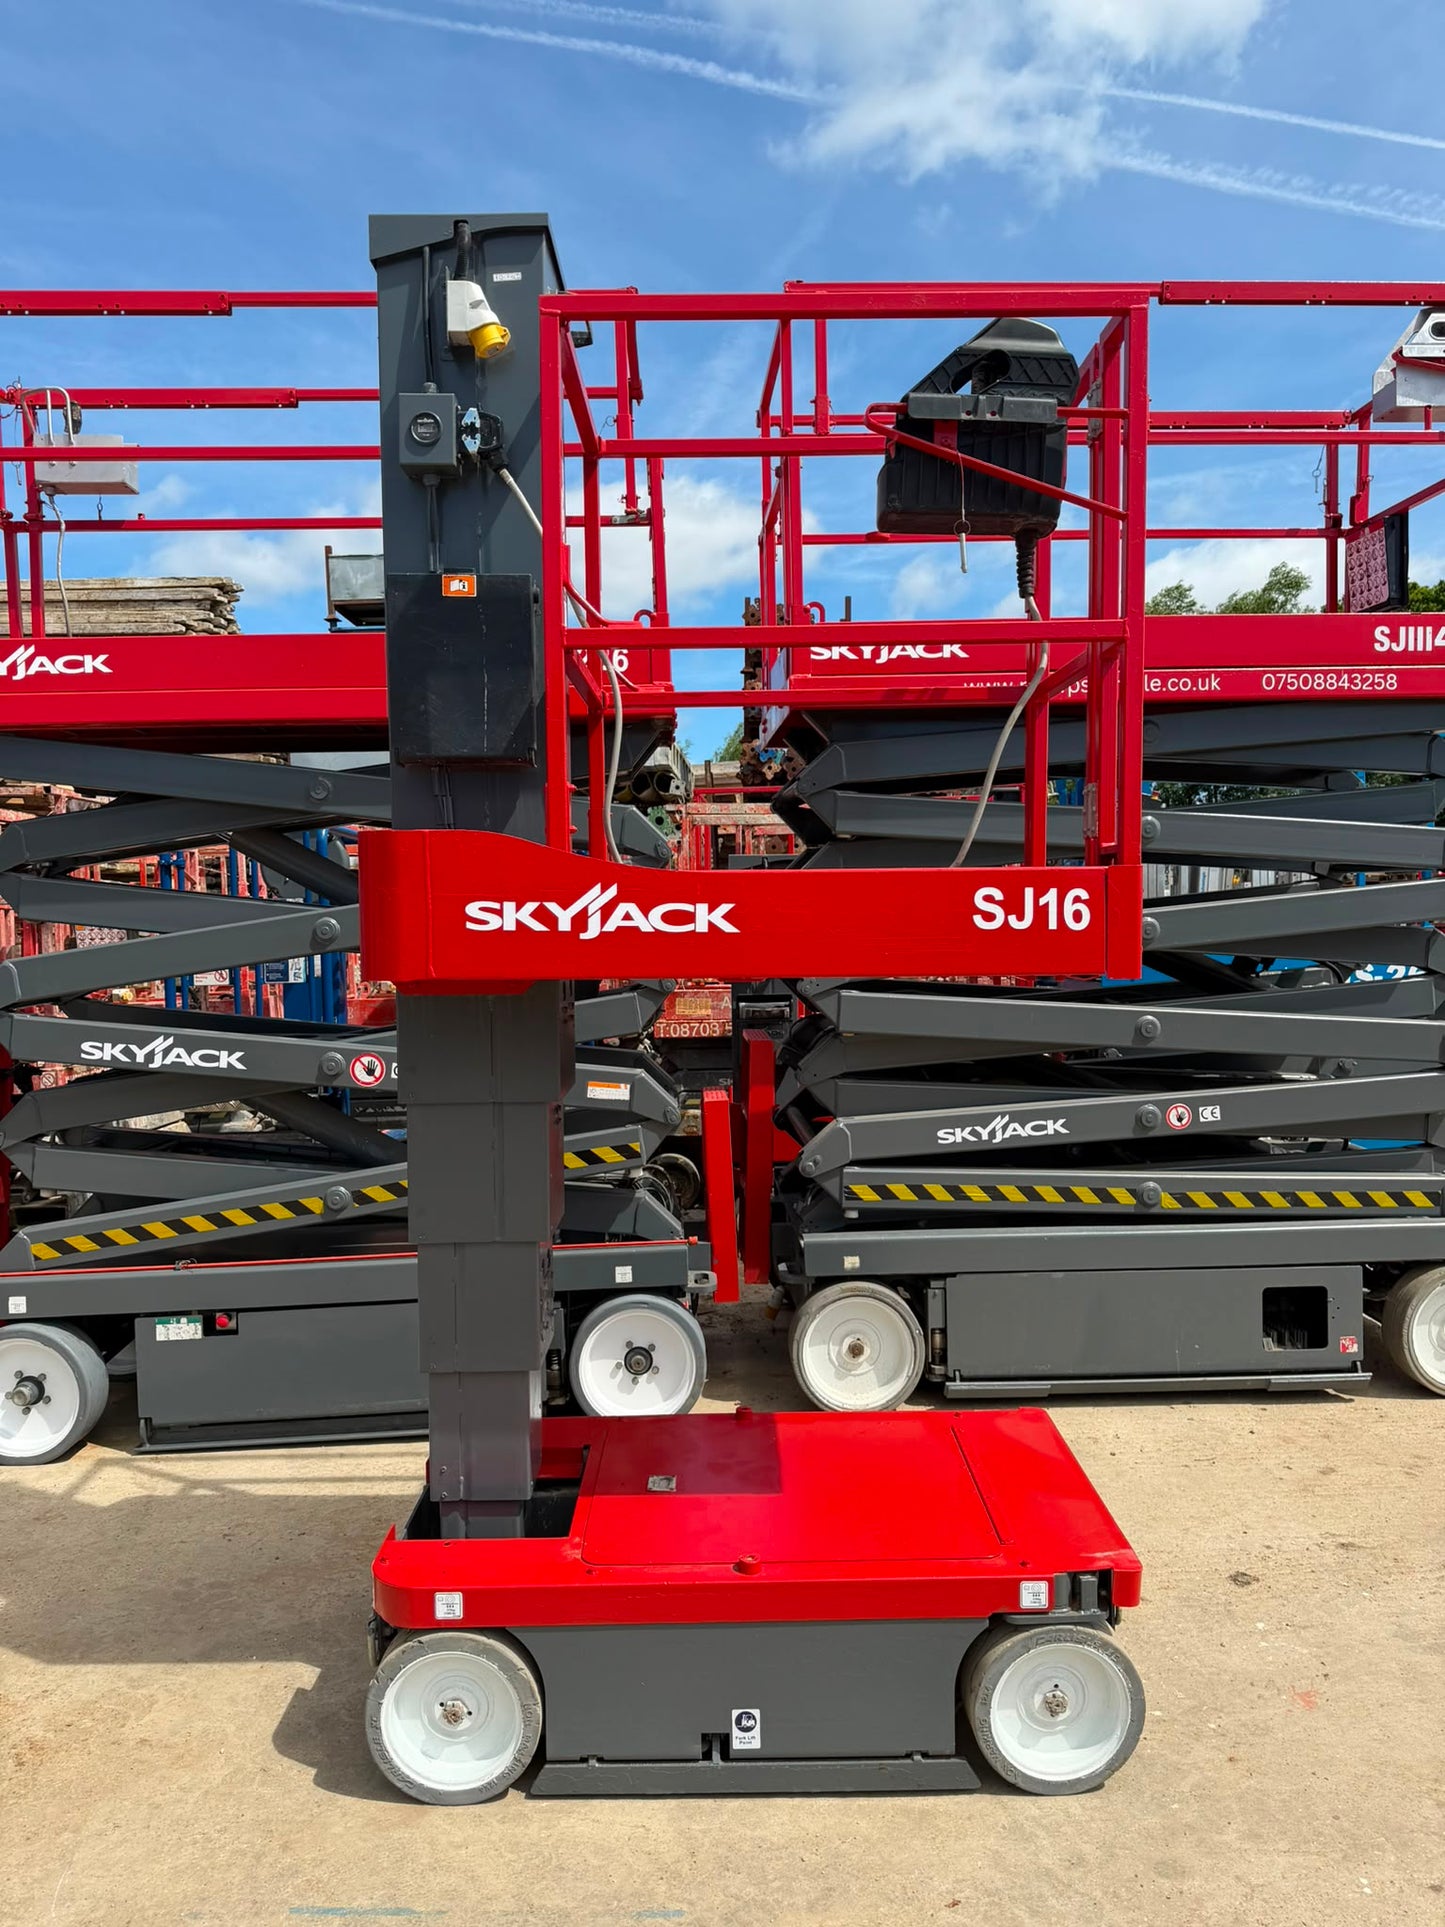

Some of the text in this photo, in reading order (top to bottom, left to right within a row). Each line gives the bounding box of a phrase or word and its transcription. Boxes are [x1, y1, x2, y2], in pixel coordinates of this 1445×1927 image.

[1262, 673, 1398, 690] 07508843258
[464, 882, 741, 940] SKYJACK
[972, 886, 1091, 931] SJ16
[80, 1035, 247, 1069] SKYJACK
[1200, 1105, 1219, 1120] CE
[937, 1114, 1070, 1144] SKYJACK
